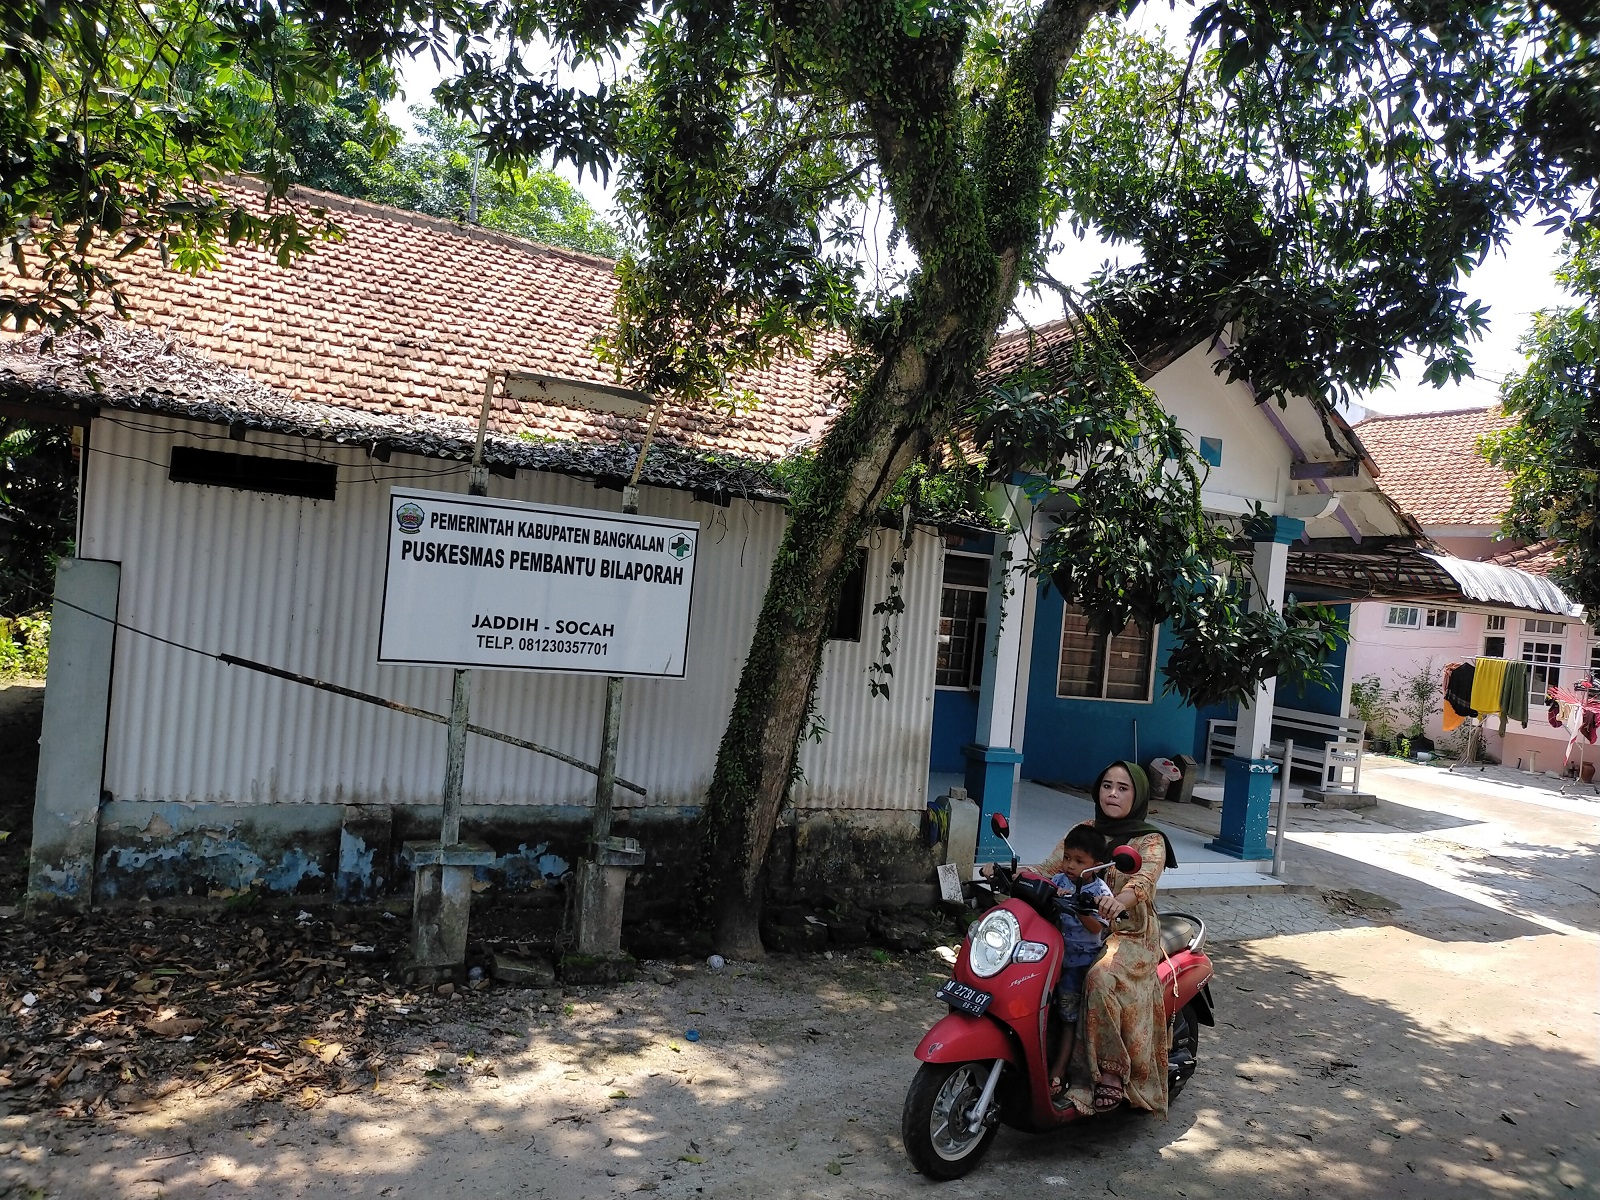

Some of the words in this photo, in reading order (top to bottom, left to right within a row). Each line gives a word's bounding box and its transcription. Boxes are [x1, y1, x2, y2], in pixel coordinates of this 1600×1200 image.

[430, 511, 515, 537] PEMERINTAH
[517, 521, 591, 544] KABUPATEN
[593, 529, 665, 553] BANGKALAN
[401, 539, 505, 569] PUSKESMAS
[509, 549, 596, 577] PEMBANTU
[599, 558, 684, 586] BILAPORAH
[471, 614, 539, 632] JADDIH
[555, 619, 615, 637] SOCAH
[476, 634, 514, 650] TELP.
[518, 637, 608, 656] 081230357701
[953, 984, 976, 1001] 2731
[974, 993, 990, 1006] GY
